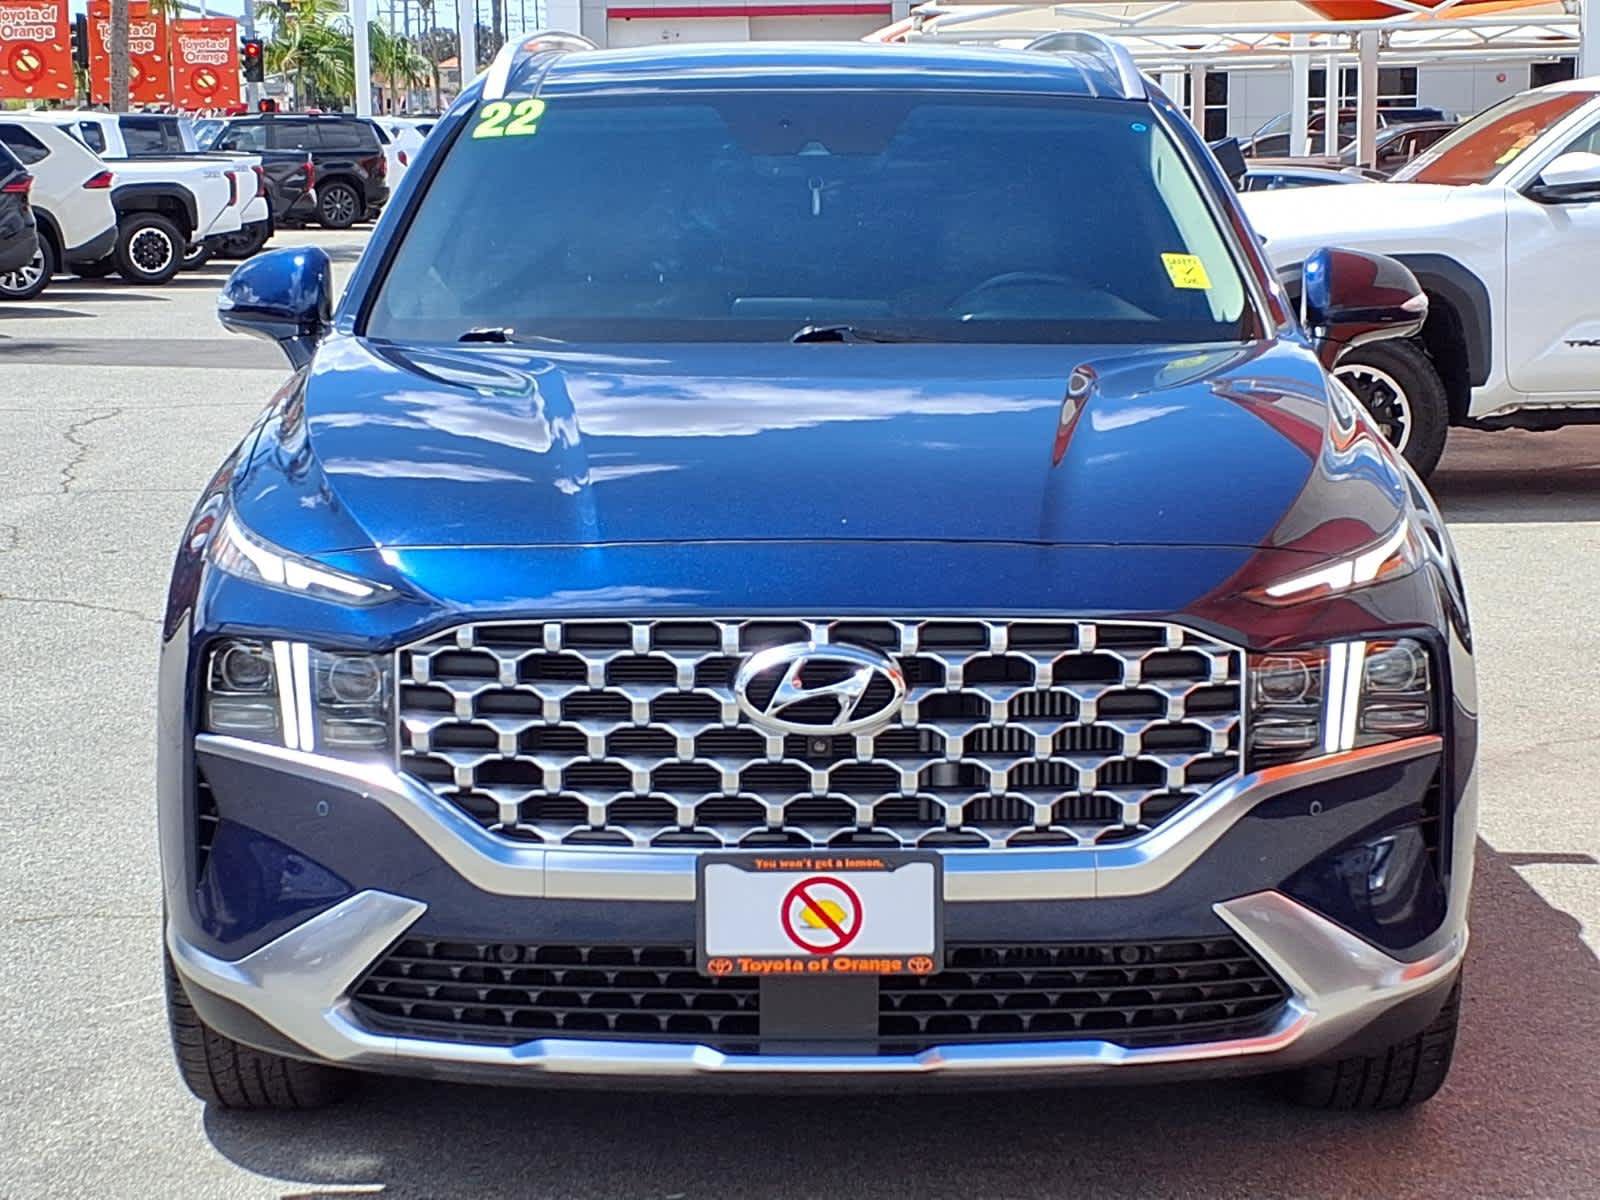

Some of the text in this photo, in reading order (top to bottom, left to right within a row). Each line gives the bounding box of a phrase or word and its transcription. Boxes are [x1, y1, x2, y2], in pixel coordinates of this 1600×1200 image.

[0, 7, 56, 23] oyota of
[1, 24, 54, 40] Orange
[142, 24, 155, 35] of
[181, 39, 228, 51] Toyota of
[185, 51, 227, 63] Orange
[472, 99, 545, 138] 22
[755, 857, 885, 871] You won't get a lemon.
[737, 956, 902, 975] Toyota of Orange
